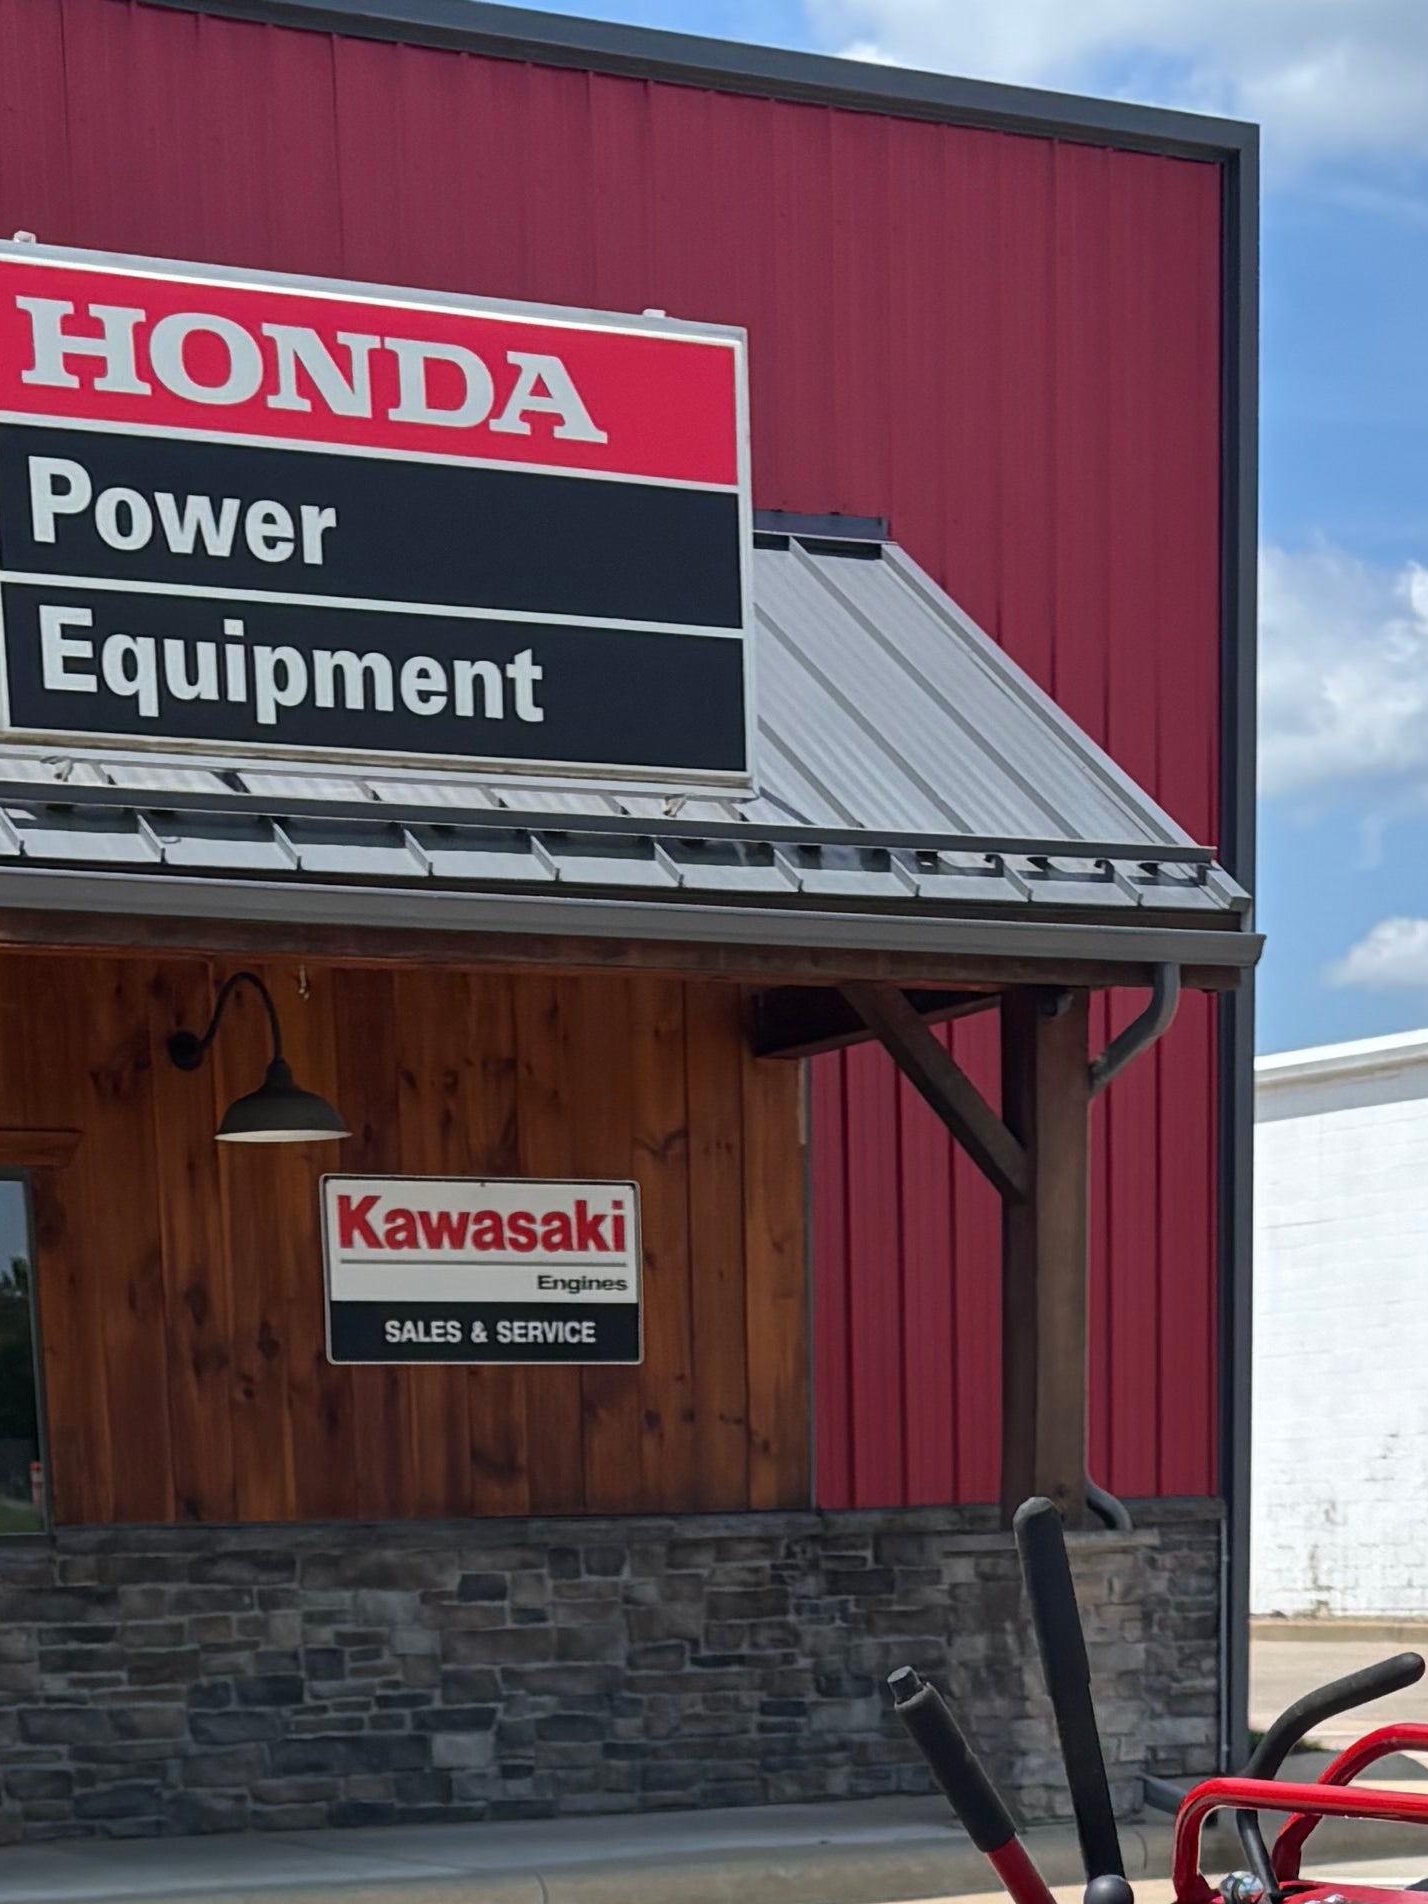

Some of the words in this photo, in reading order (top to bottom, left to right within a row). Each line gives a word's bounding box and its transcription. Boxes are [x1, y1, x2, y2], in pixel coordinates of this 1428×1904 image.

[14, 294, 608, 445] HONDA
[27, 454, 337, 566] Power
[38, 603, 545, 725] Equipment
[337, 1194, 627, 1253] Kawasaki
[536, 1274, 629, 1294] Engines
[385, 1320, 463, 1344] SALES
[471, 1320, 489, 1344] &
[496, 1320, 597, 1344] SERVICE
